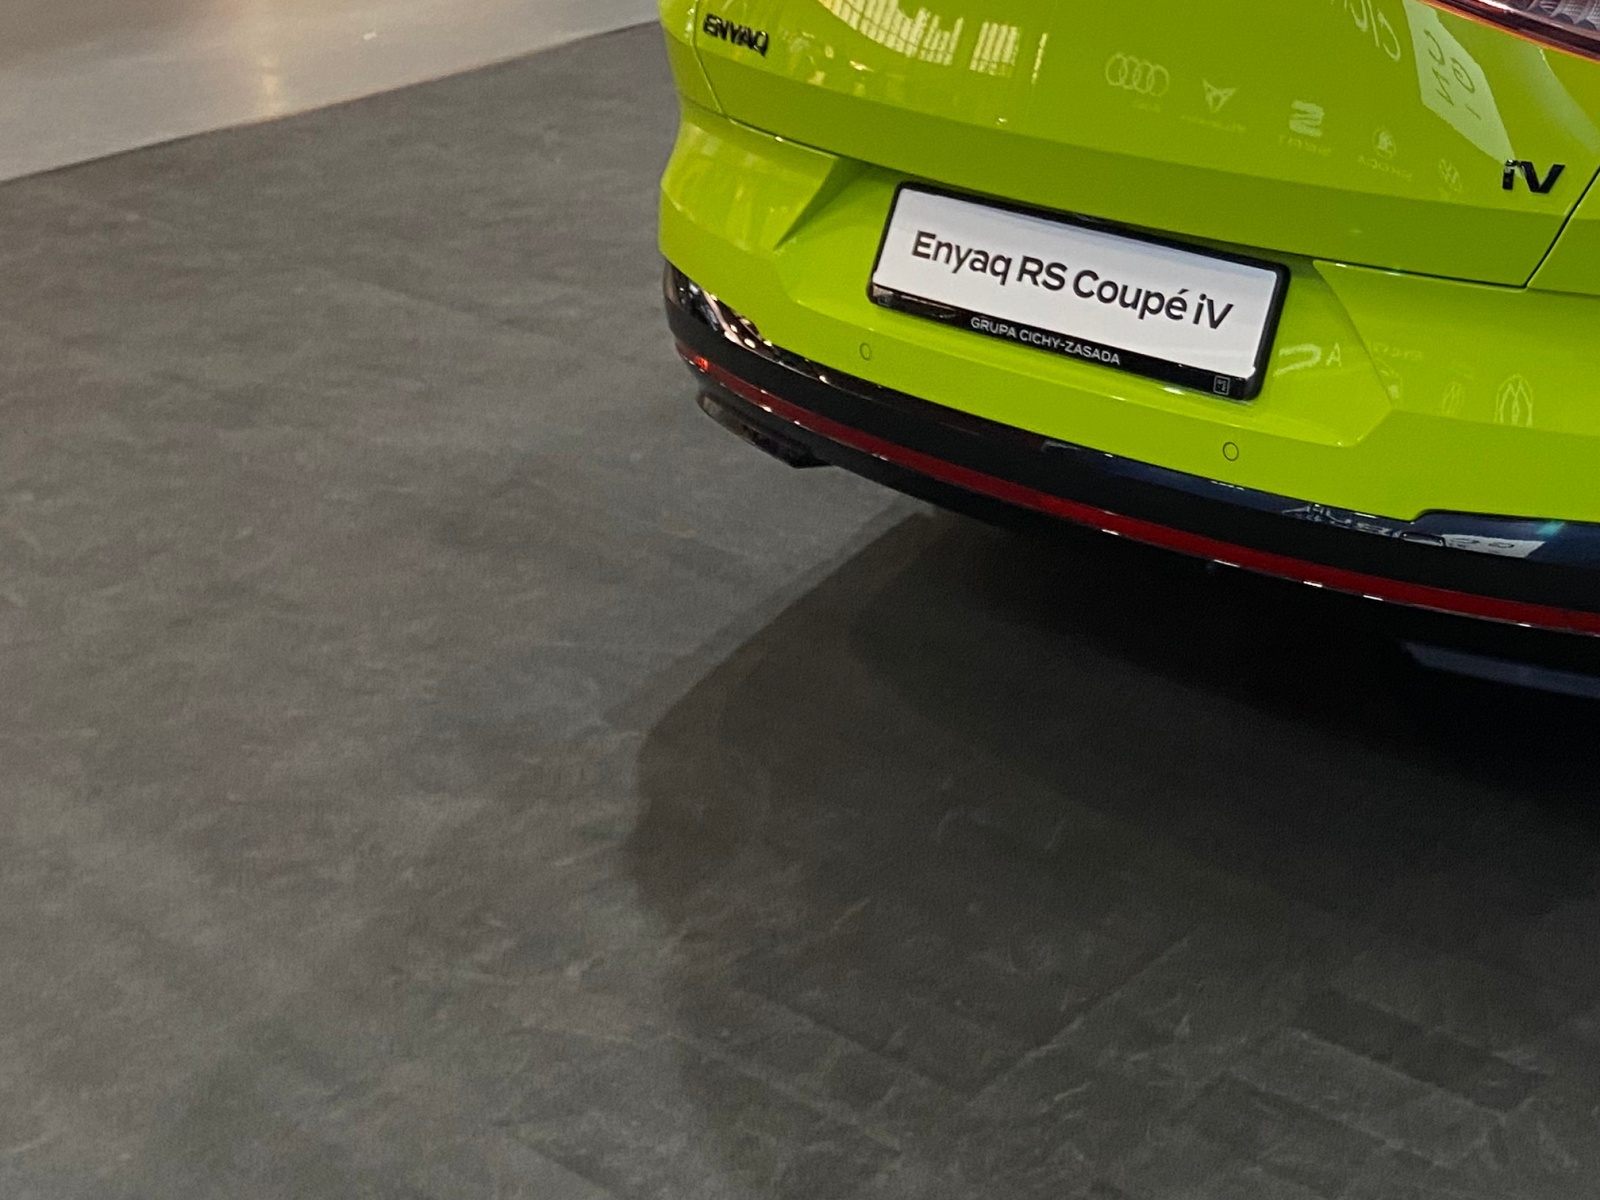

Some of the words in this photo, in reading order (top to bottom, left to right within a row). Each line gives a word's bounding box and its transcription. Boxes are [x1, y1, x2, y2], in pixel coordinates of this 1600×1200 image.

[703, 13, 770, 57] ENYAQ
[1502, 159, 1566, 194] iV
[911, 230, 1012, 286] Enyaq
[1016, 255, 1068, 292] RS
[1072, 270, 1189, 320] Coupé
[1192, 293, 1234, 330] iV
[970, 316, 1017, 338] GRUPA
[1018, 329, 1122, 366] CICHY-ZASADA
